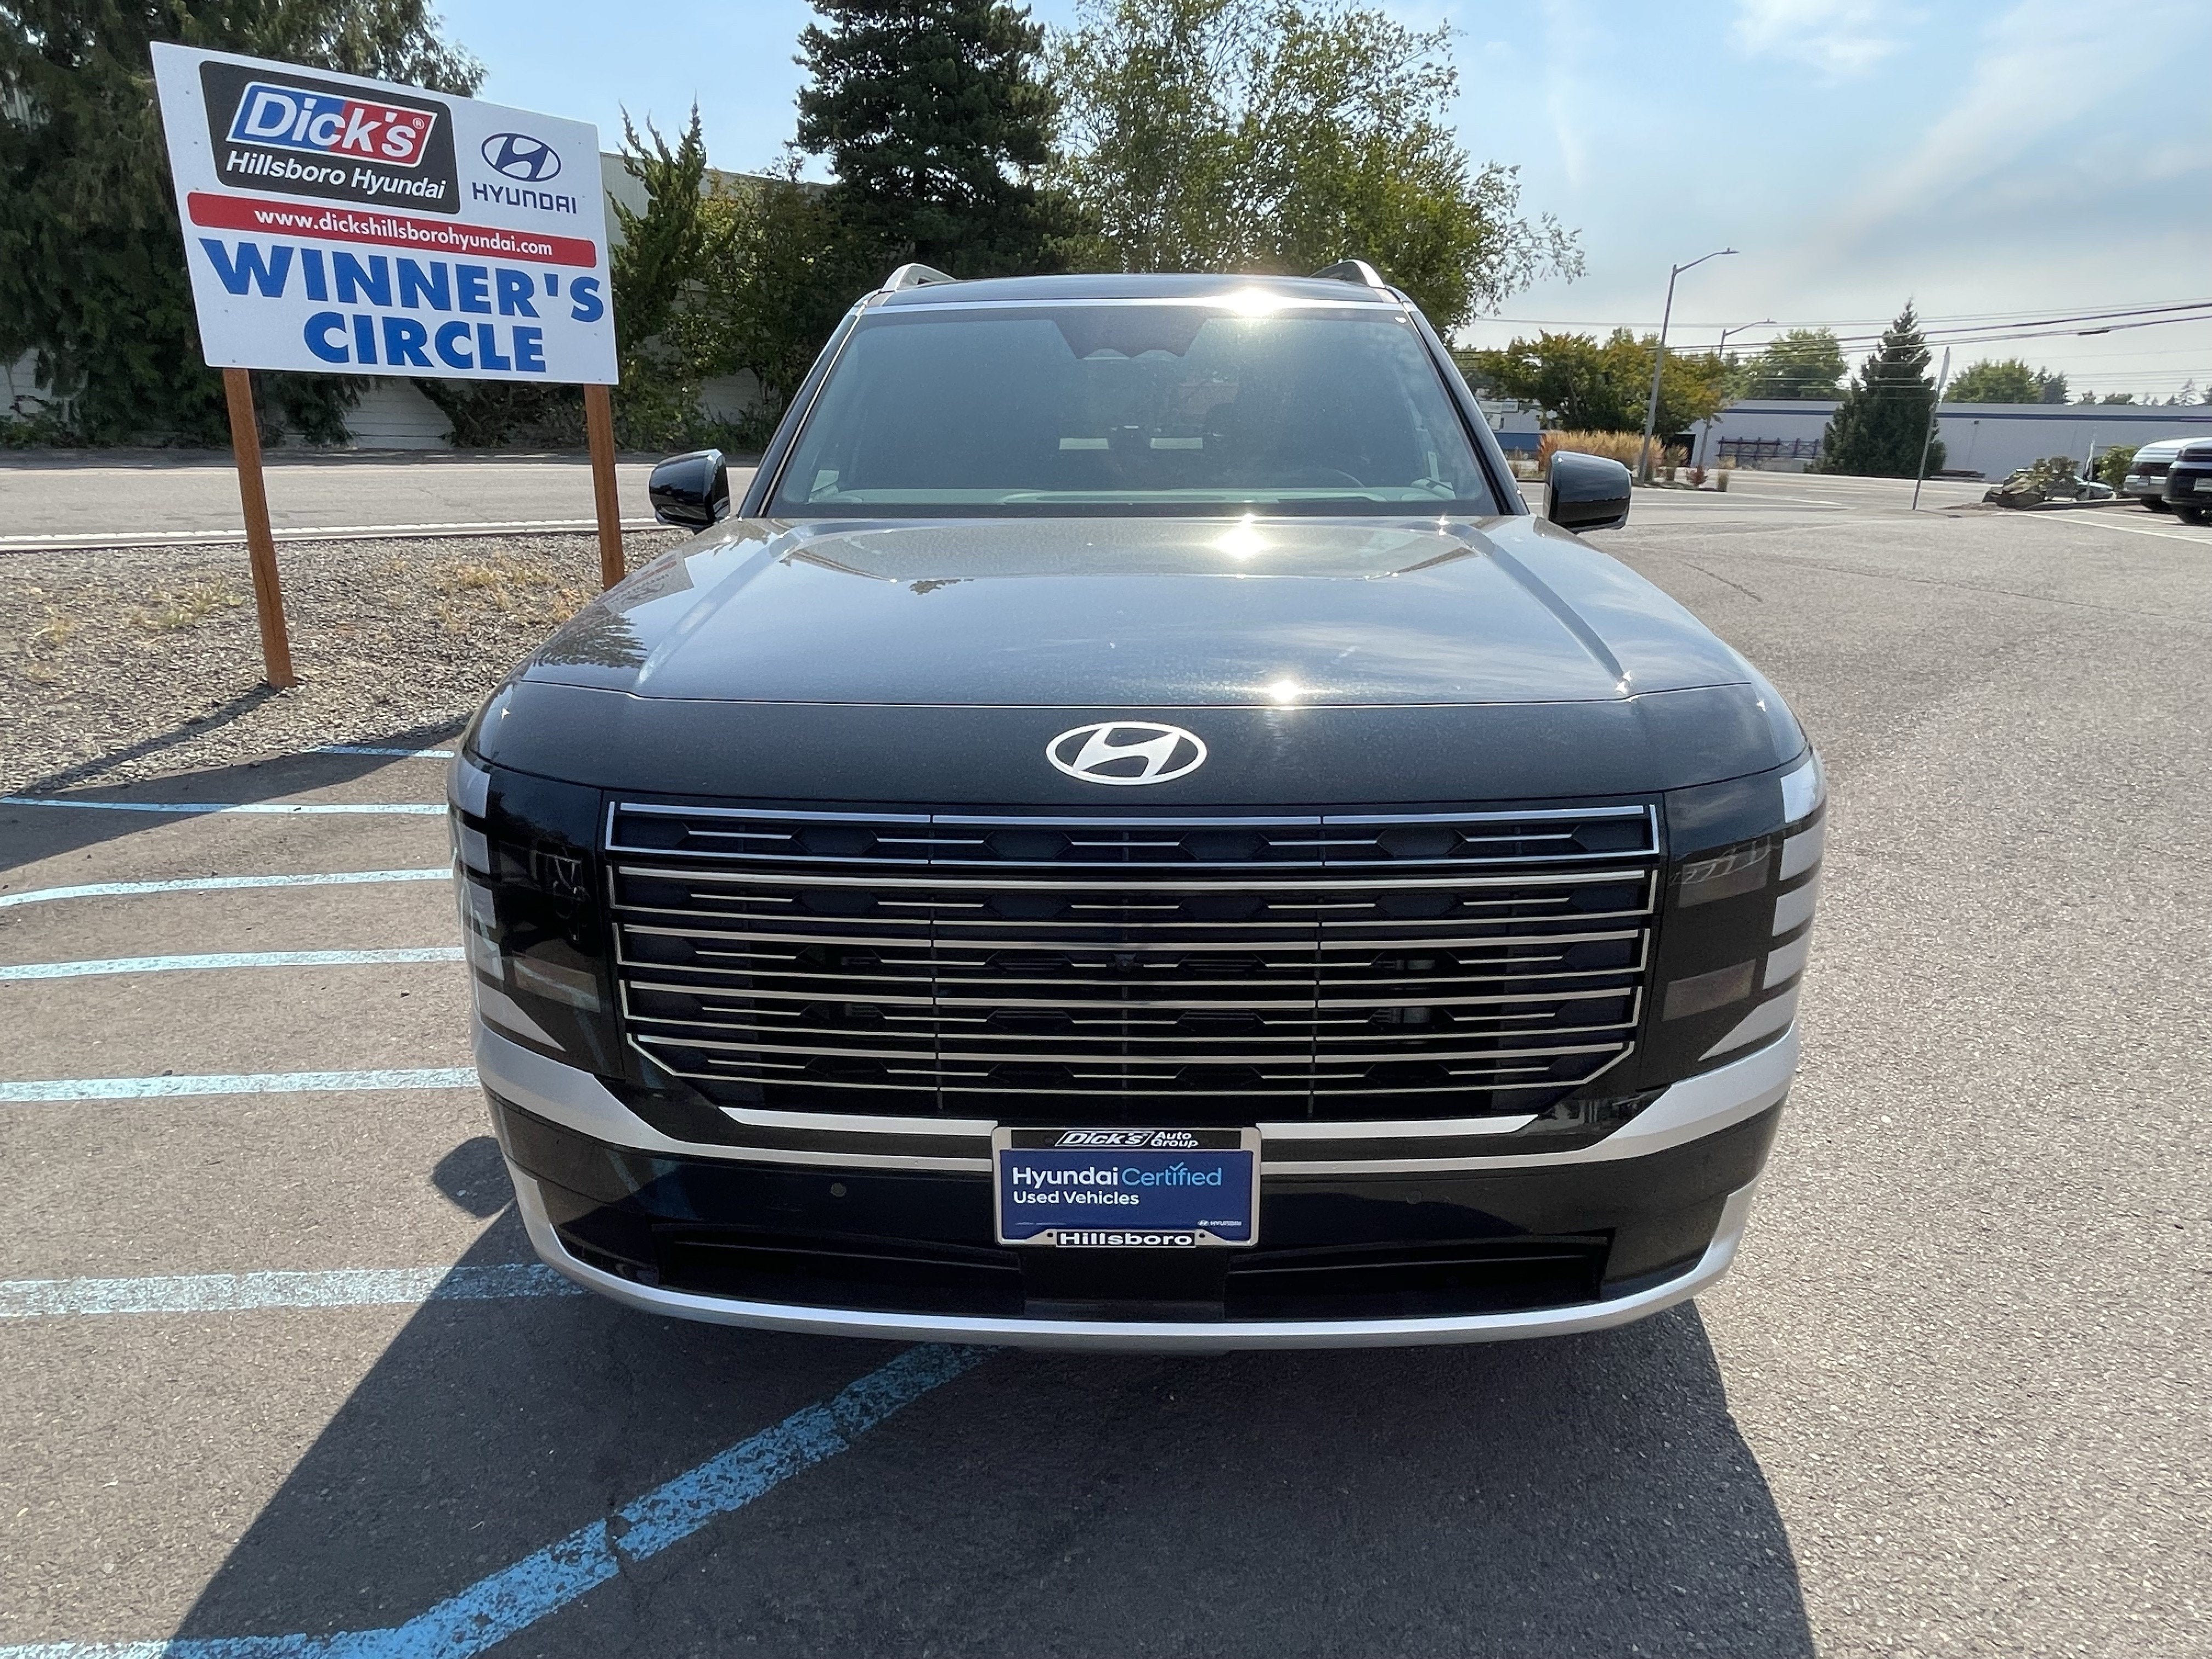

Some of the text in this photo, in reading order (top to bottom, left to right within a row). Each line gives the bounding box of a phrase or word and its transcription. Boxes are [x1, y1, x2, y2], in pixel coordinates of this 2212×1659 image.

[245, 92, 416, 157] Dick's
[226, 150, 446, 199] Hillsboro Hyundai
[472, 182, 577, 215] HYUNDAI
[255, 210, 553, 256] www.dickshillsborohyundai.com
[198, 237, 604, 323] WINNER'S
[303, 312, 546, 373] CIRCLE
[1062, 1132, 1143, 1145] Dick's
[1150, 1139, 1199, 1148] Group
[1153, 1131, 1192, 1140] Auto
[1012, 1162, 1222, 1189] Hyundai Certified
[1013, 1190, 1140, 1205] Used Vehicles
[1060, 1232, 1193, 1245] Hillsboro
